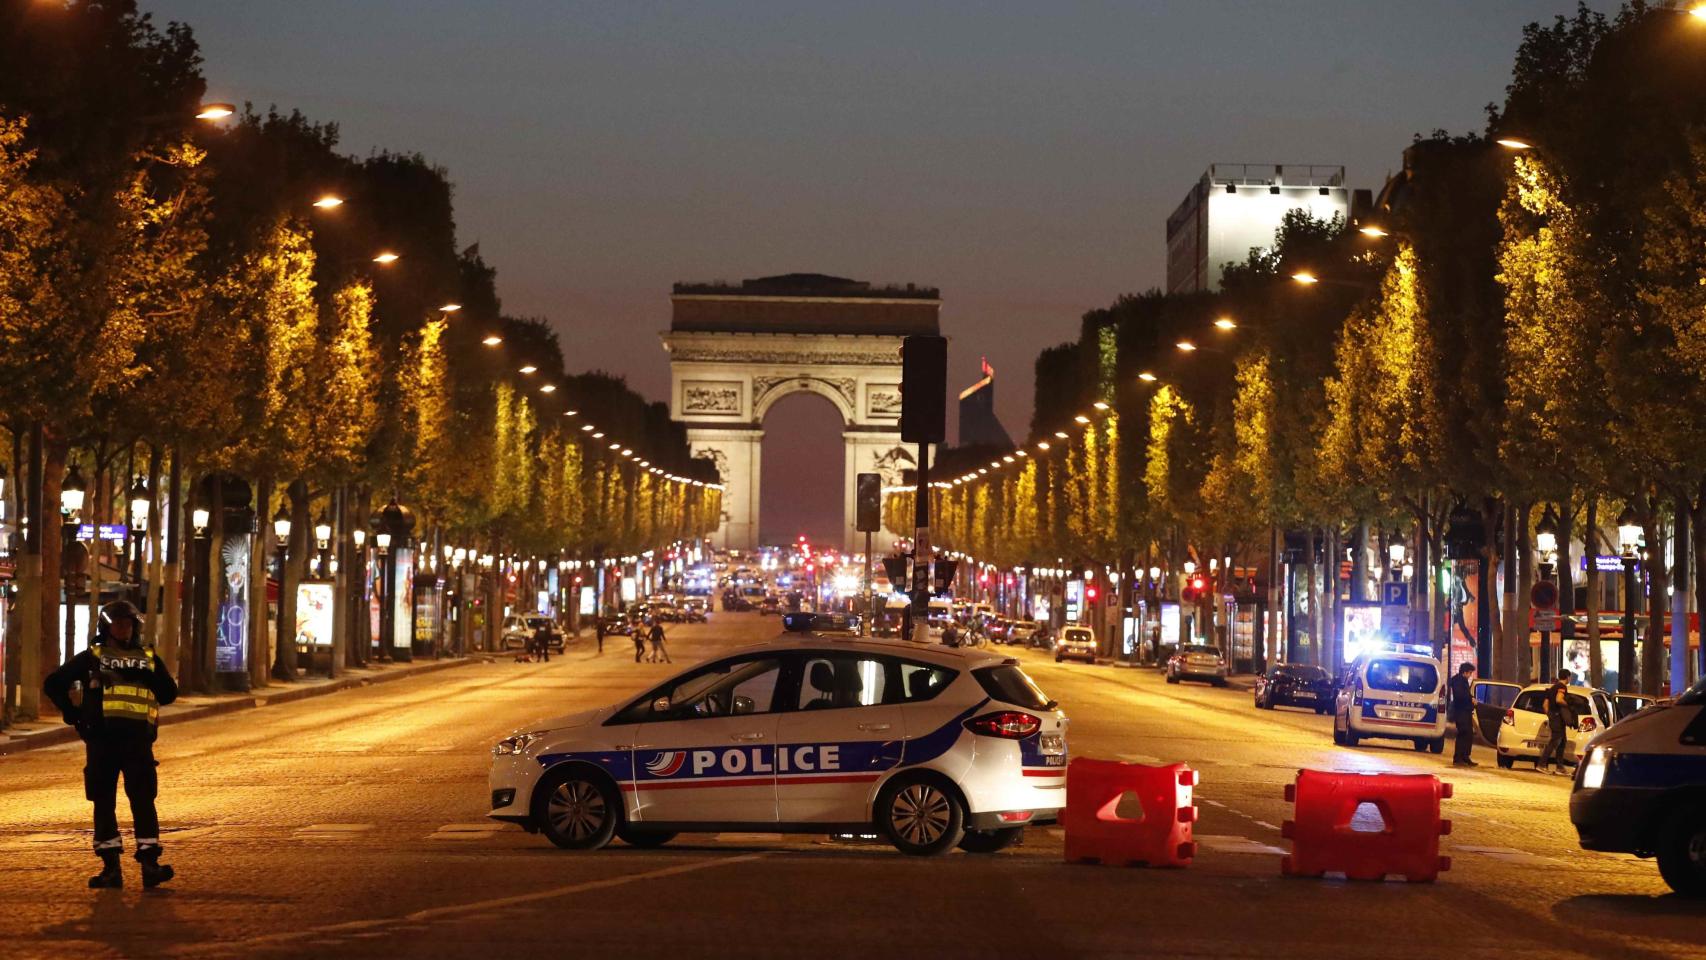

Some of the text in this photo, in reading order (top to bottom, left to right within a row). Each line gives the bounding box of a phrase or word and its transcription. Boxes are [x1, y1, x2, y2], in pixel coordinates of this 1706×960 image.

[1391, 585, 1401, 602] P
[693, 745, 840, 775] POLICE
[1046, 756, 1064, 766] POLICE
